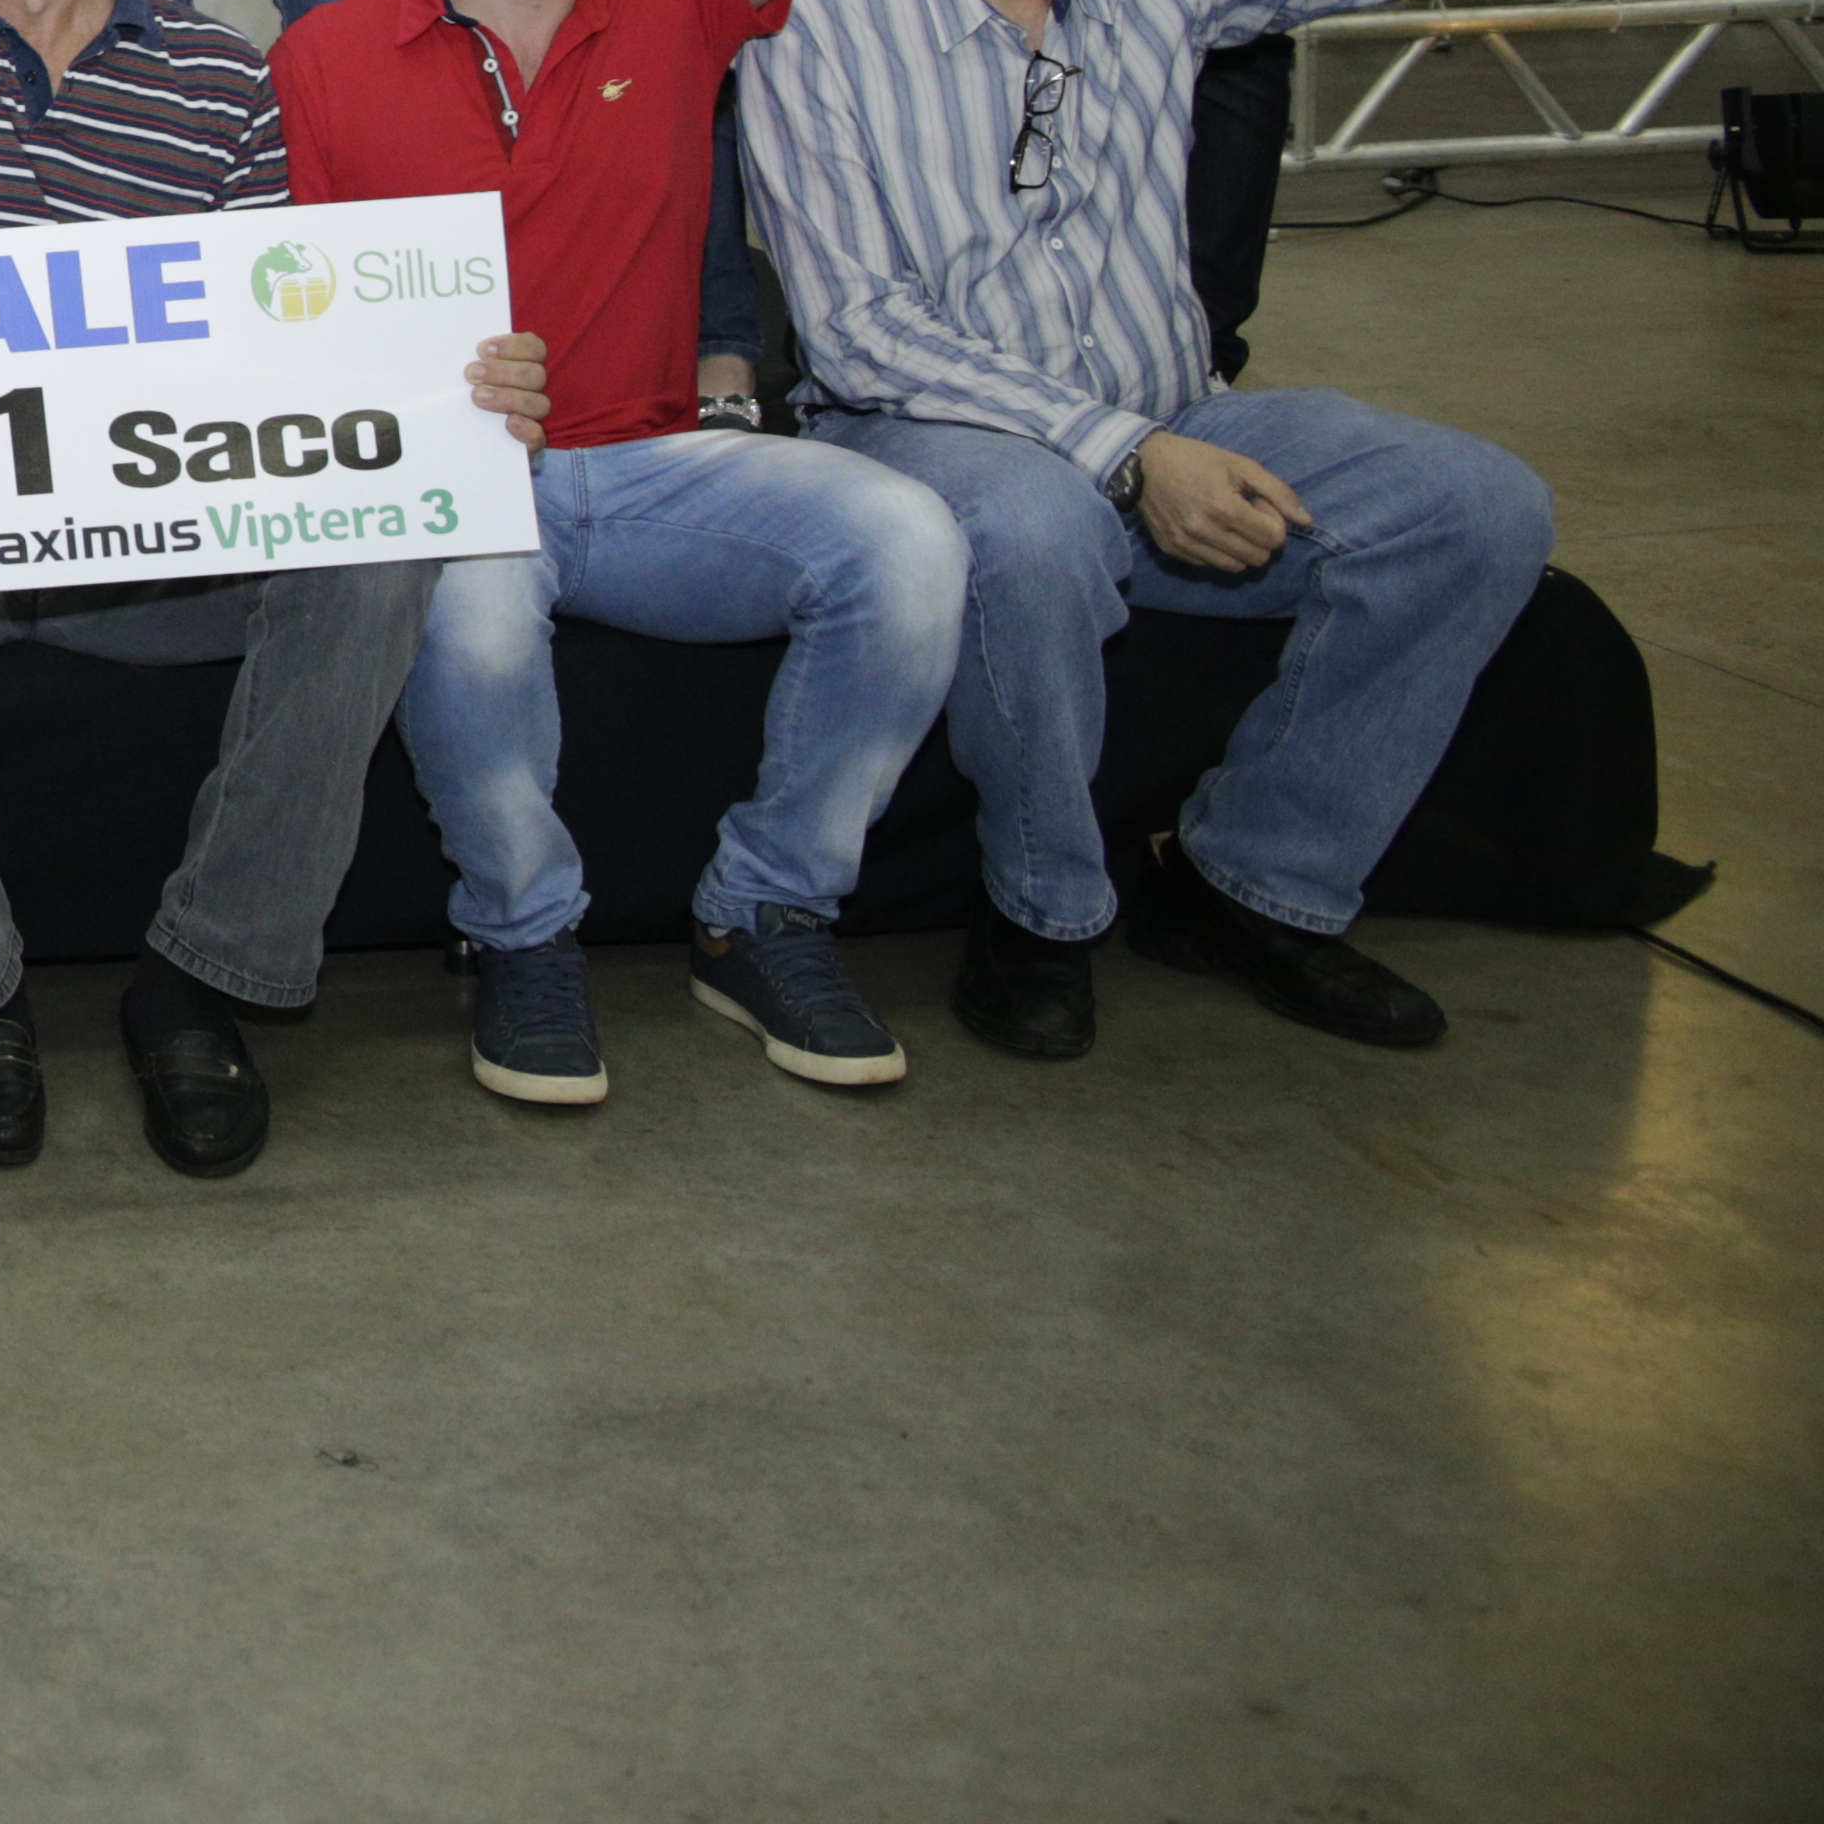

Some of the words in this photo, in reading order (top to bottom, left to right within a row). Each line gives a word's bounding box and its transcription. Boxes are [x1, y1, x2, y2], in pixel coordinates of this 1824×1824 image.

[354, 248, 494, 303] Sillus
[108, 409, 402, 489] Saco
[205, 502, 407, 559] Viptera
[419, 488, 459, 535] 3
